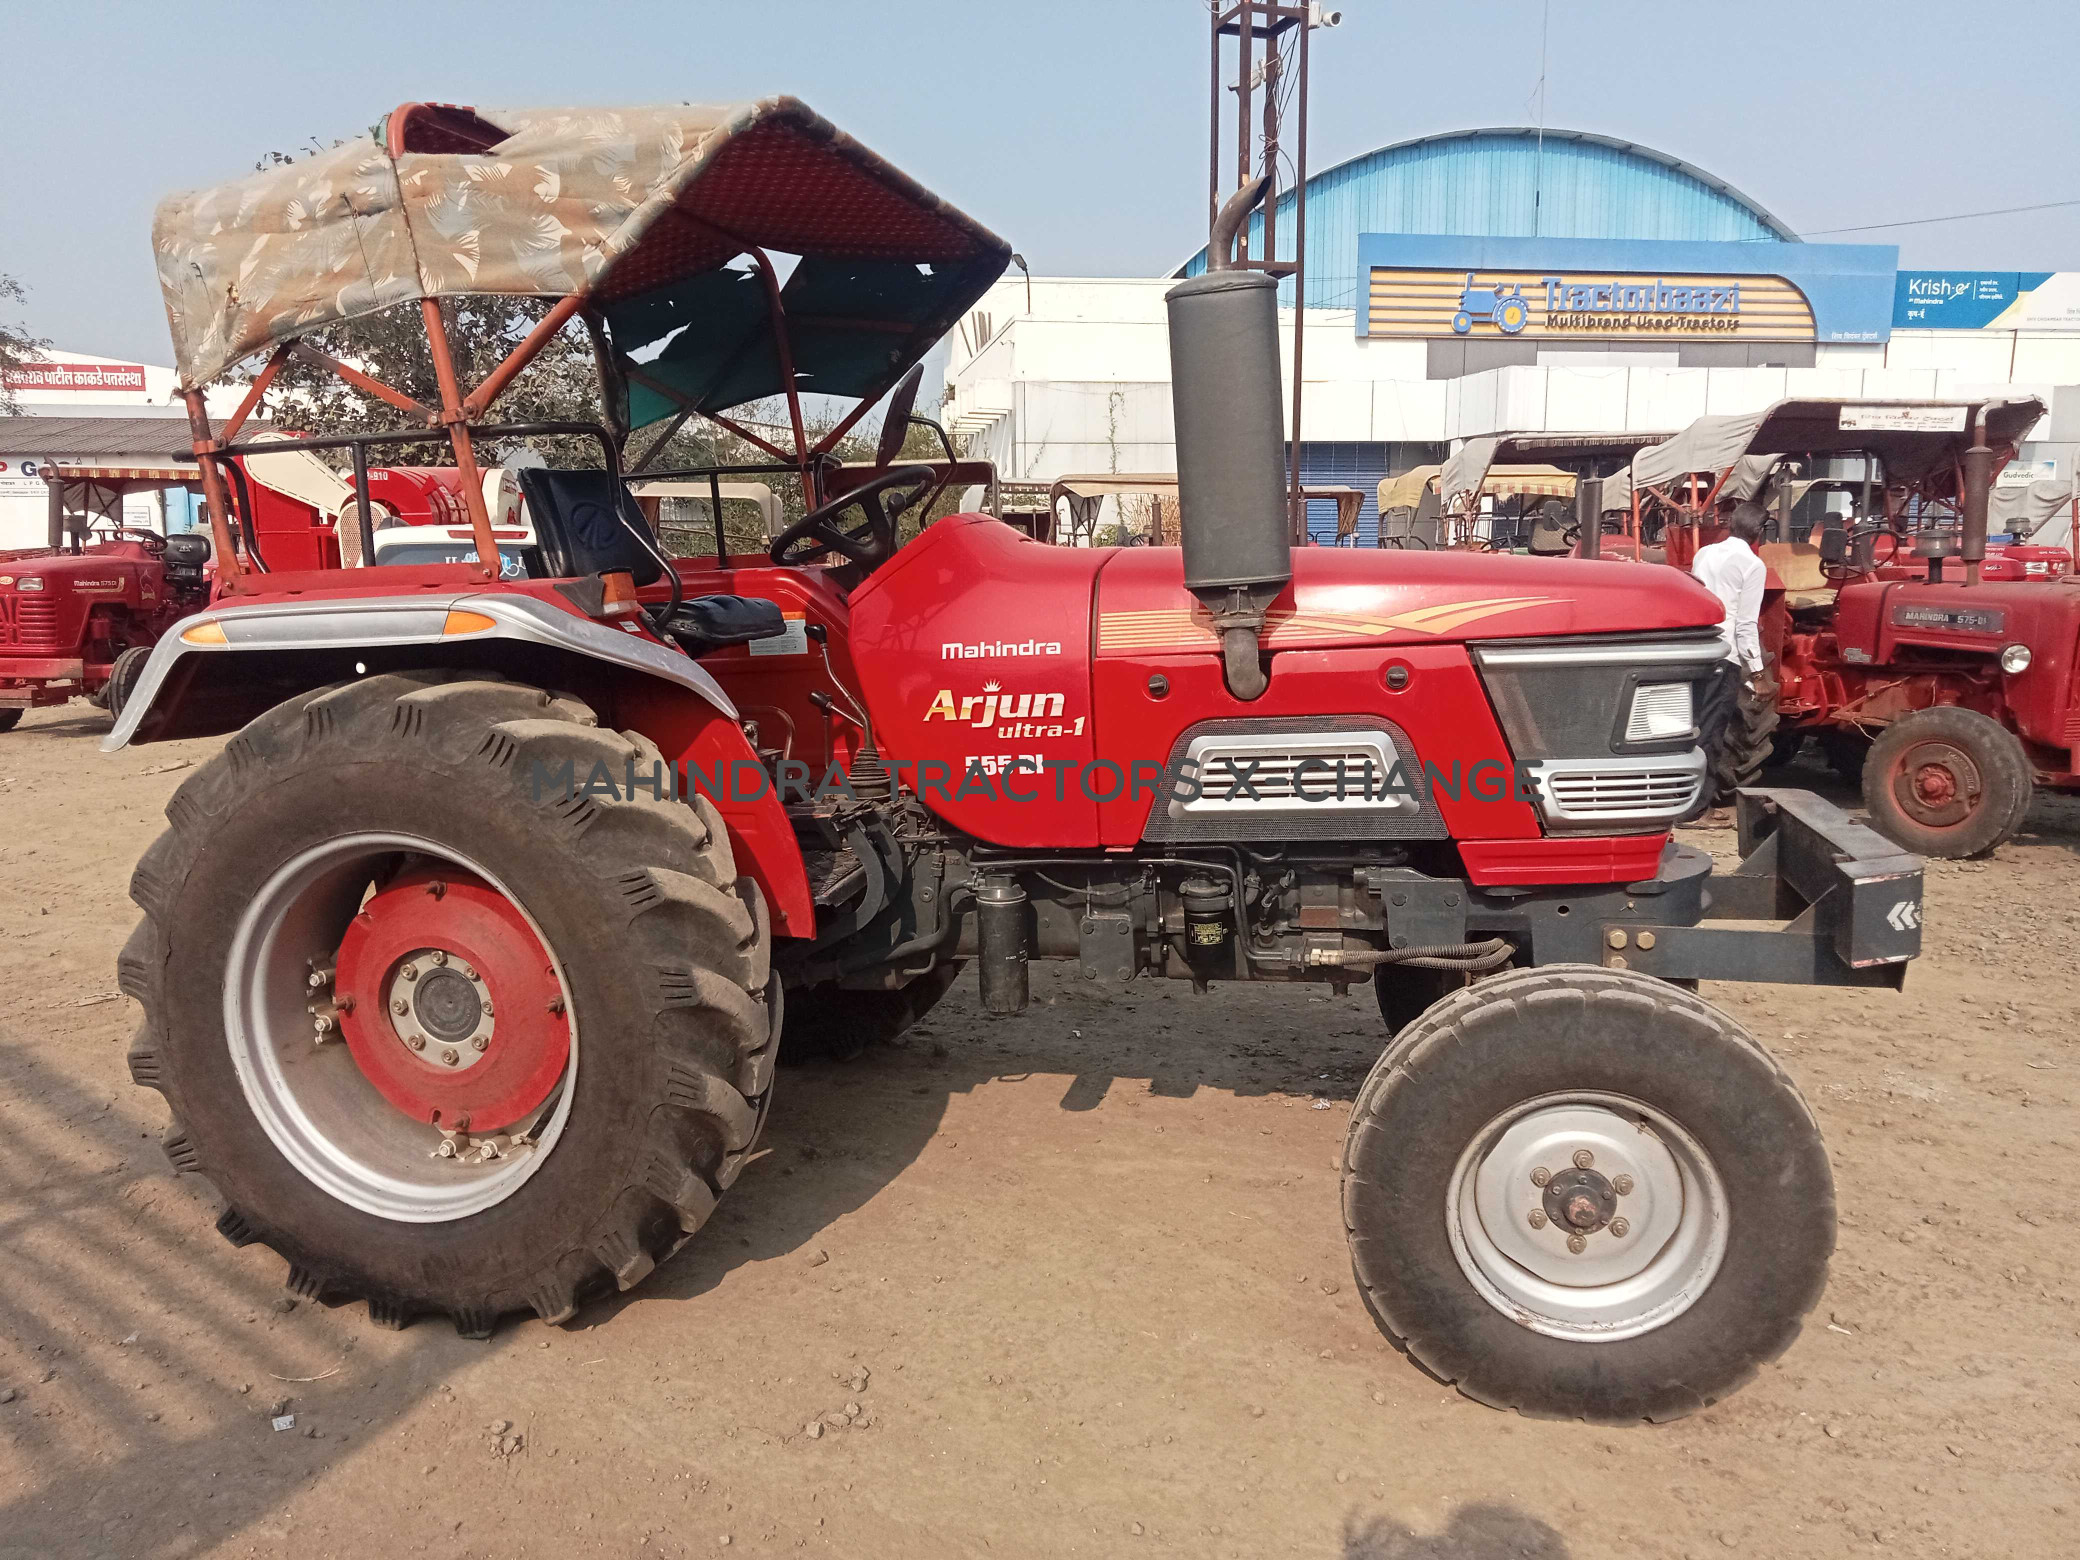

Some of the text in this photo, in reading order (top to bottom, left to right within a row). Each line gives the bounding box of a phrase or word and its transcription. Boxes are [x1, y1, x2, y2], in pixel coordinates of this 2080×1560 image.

[1541, 277, 1740, 313] Tractorbaazi
[1545, 314, 1740, 330] Multibrand Used Tractors
[2003, 471, 2034, 479] Gudvedic
[1905, 612, 1949, 622] MAHINDRA
[942, 639, 1061, 660] Mahindra
[922, 679, 1065, 728] Arjun
[998, 716, 1085, 739] ultra-1
